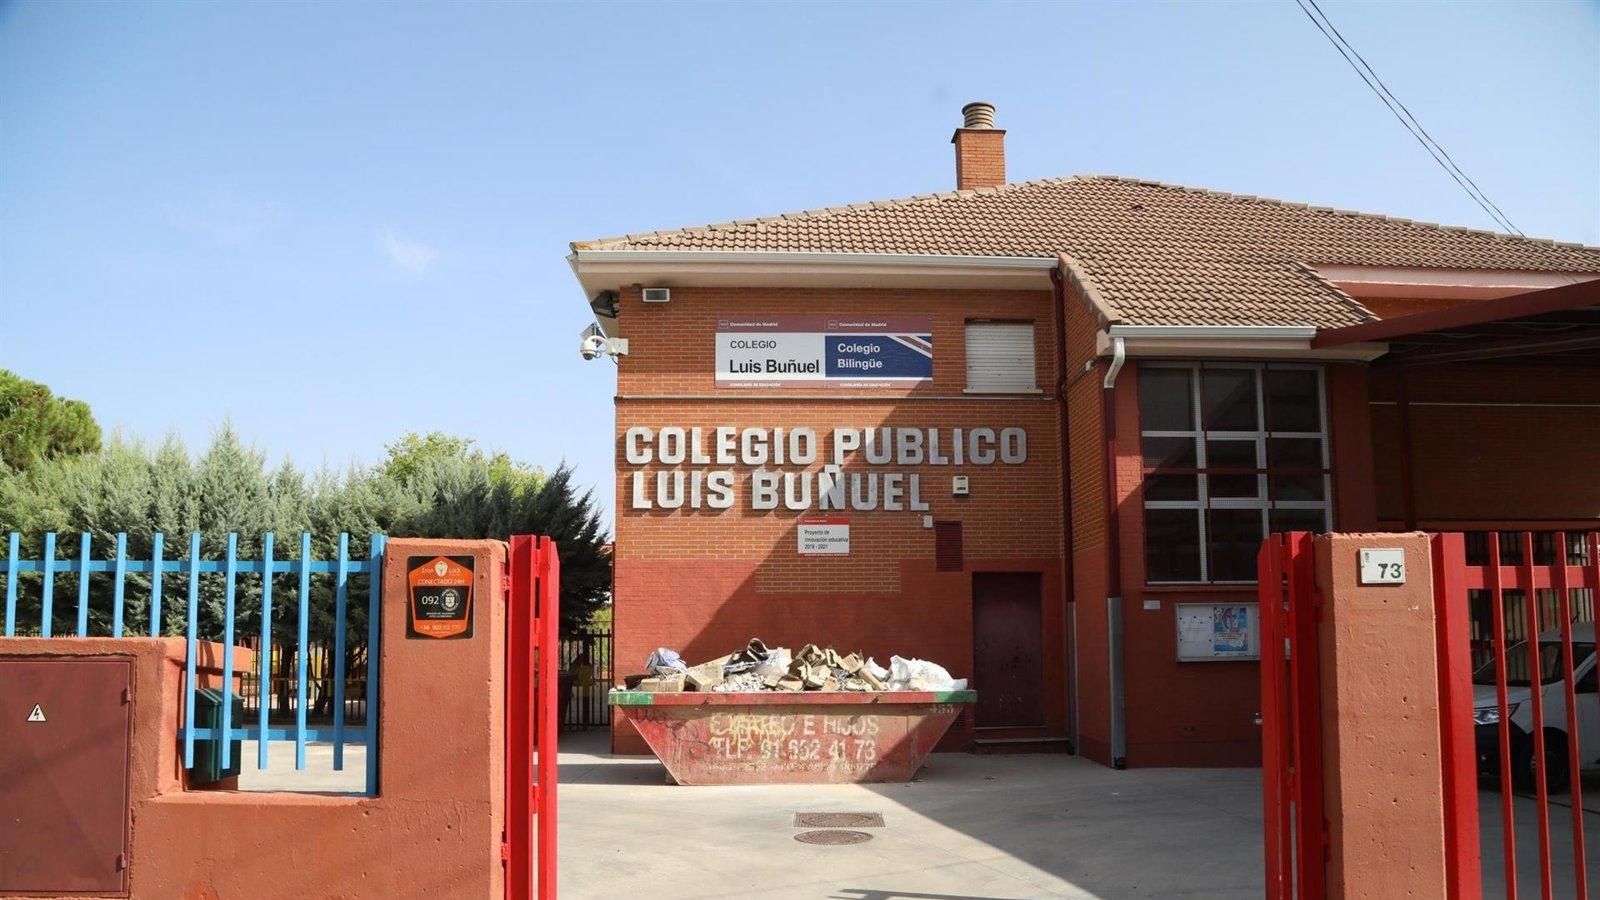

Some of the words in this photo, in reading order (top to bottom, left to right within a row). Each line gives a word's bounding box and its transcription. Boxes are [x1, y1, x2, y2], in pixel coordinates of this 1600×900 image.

[730, 340, 777, 349] COLEGIO
[838, 343, 880, 355] Colegio
[729, 360, 762, 373] Luis
[766, 359, 820, 373] Buñuel
[838, 358, 883, 370] Bilingüe
[625, 426, 817, 466] COLEGIO
[834, 427, 1027, 466] PUBLICO
[632, 471, 736, 510] LUIS
[751, 464, 929, 511] BUÑUEL
[1378, 563, 1402, 579] 73
[421, 595, 440, 605] 092
[803, 714, 816, 735] E
[823, 714, 879, 736] HIJOS
[828, 739, 846, 760] 41
[854, 738, 876, 760] 73
